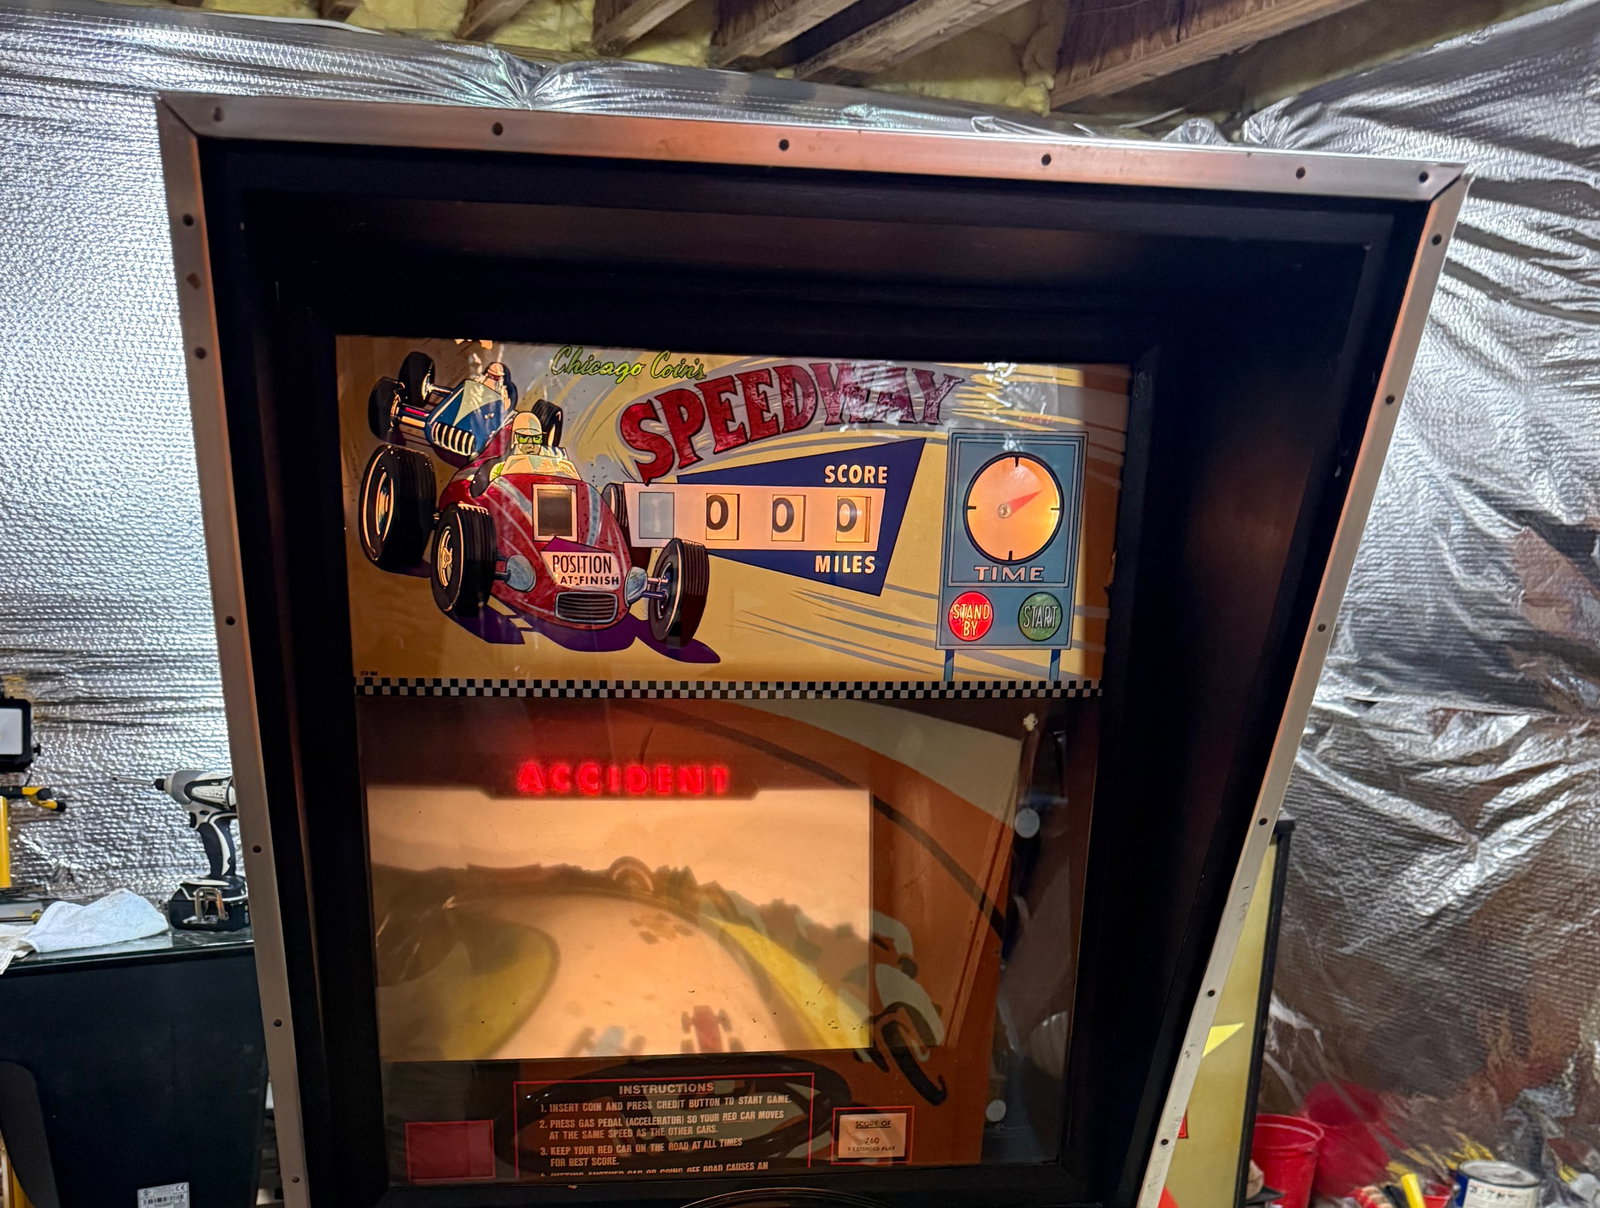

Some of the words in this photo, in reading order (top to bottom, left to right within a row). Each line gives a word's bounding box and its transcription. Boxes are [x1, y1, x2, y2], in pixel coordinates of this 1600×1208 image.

[551, 345, 645, 384] Chicago
[650, 351, 706, 380] Coin's
[619, 362, 965, 486] SPEEDWAY
[824, 464, 888, 484] SCORE
[706, 495, 729, 531] 0
[772, 497, 795, 533] 0
[837, 498, 858, 533] 0
[553, 555, 612, 573] POSITION
[815, 555, 876, 574] MILES
[974, 565, 1045, 581] TIME
[560, 576, 573, 584] AT
[580, 576, 619, 585] FINISH
[953, 603, 990, 620] STAND
[1023, 604, 1058, 629] START
[963, 620, 979, 637] BY
[517, 762, 729, 795] ACCIDENT
[619, 1083, 714, 1095] INSTRUCTIONS
[550, 1103, 579, 1112] INSERT
[582, 1102, 601, 1111] COIN
[606, 1102, 623, 1111] AND
[627, 1101, 652, 1110] PRESS
[657, 1099, 685, 1109] CREDIT
[689, 1097, 720, 1107] BUTTON
[724, 1097, 734, 1105] TO
[738, 1096, 762, 1105] START
[550, 1119, 575, 1128] PRESS
[579, 1119, 595, 1127] GAS
[598, 1118, 622, 1127] PEDAL
[687, 1115, 697, 1123] SO
[700, 1113, 719, 1122] YOUR
[722, 1112, 737, 1121] RED
[740, 1111, 755, 1120] CAR
[758, 1110, 784, 1119] MOVES
[550, 1131, 560, 1140] AT
[563, 1131, 579, 1139] THE
[582, 1130, 604, 1139] SAME
[608, 1129, 633, 1138] SPEED
[636, 1128, 647, 1137] AS
[651, 1128, 665, 1137] THE
[668, 1126, 693, 1136] OTHER
[696, 1125, 718, 1134] CARS.
[550, 1147, 571, 1156] KEEP
[574, 1146, 594, 1155] YOUR
[597, 1145, 613, 1154] RED
[616, 1145, 632, 1154] CAR
[635, 1144, 646, 1153] ON
[650, 1143, 665, 1152] THE
[668, 1142, 688, 1151] ROAD
[692, 1141, 700, 1150] AT
[703, 1140, 717, 1149] ALL
[720, 1138, 743, 1148] TIMES
[550, 1158, 566, 1167] FOR
[569, 1158, 589, 1167] BEST
[591, 1157, 619, 1166] SCORE.
[726, 1162, 755, 1171] CAUSES
